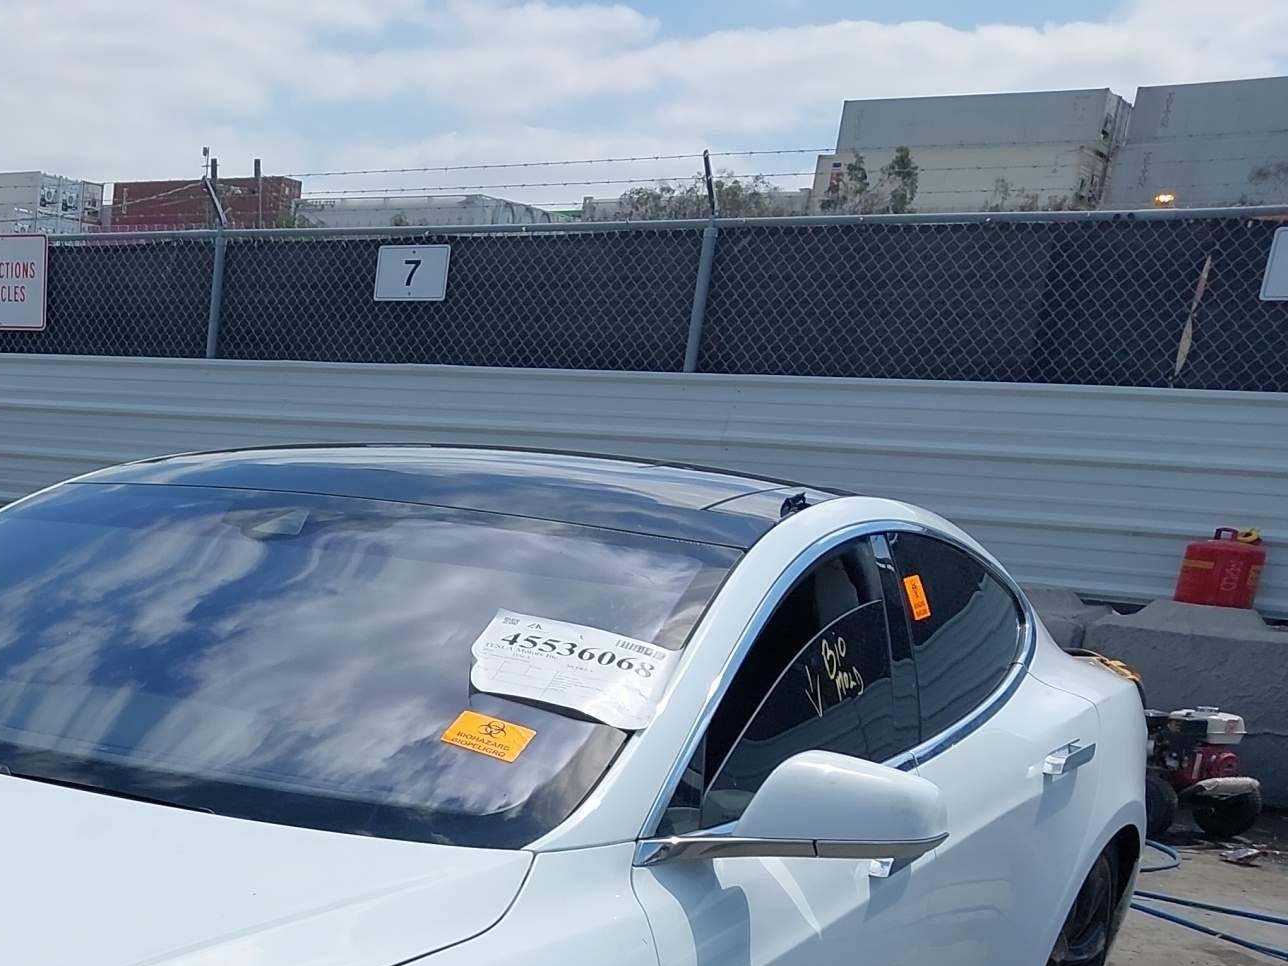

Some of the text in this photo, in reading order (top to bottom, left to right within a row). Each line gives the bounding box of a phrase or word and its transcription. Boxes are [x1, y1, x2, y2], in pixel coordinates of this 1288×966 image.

[404, 259, 422, 287] 7
[500, 632, 656, 679] 45536068
[456, 731, 511, 752] BIOHAZARD
